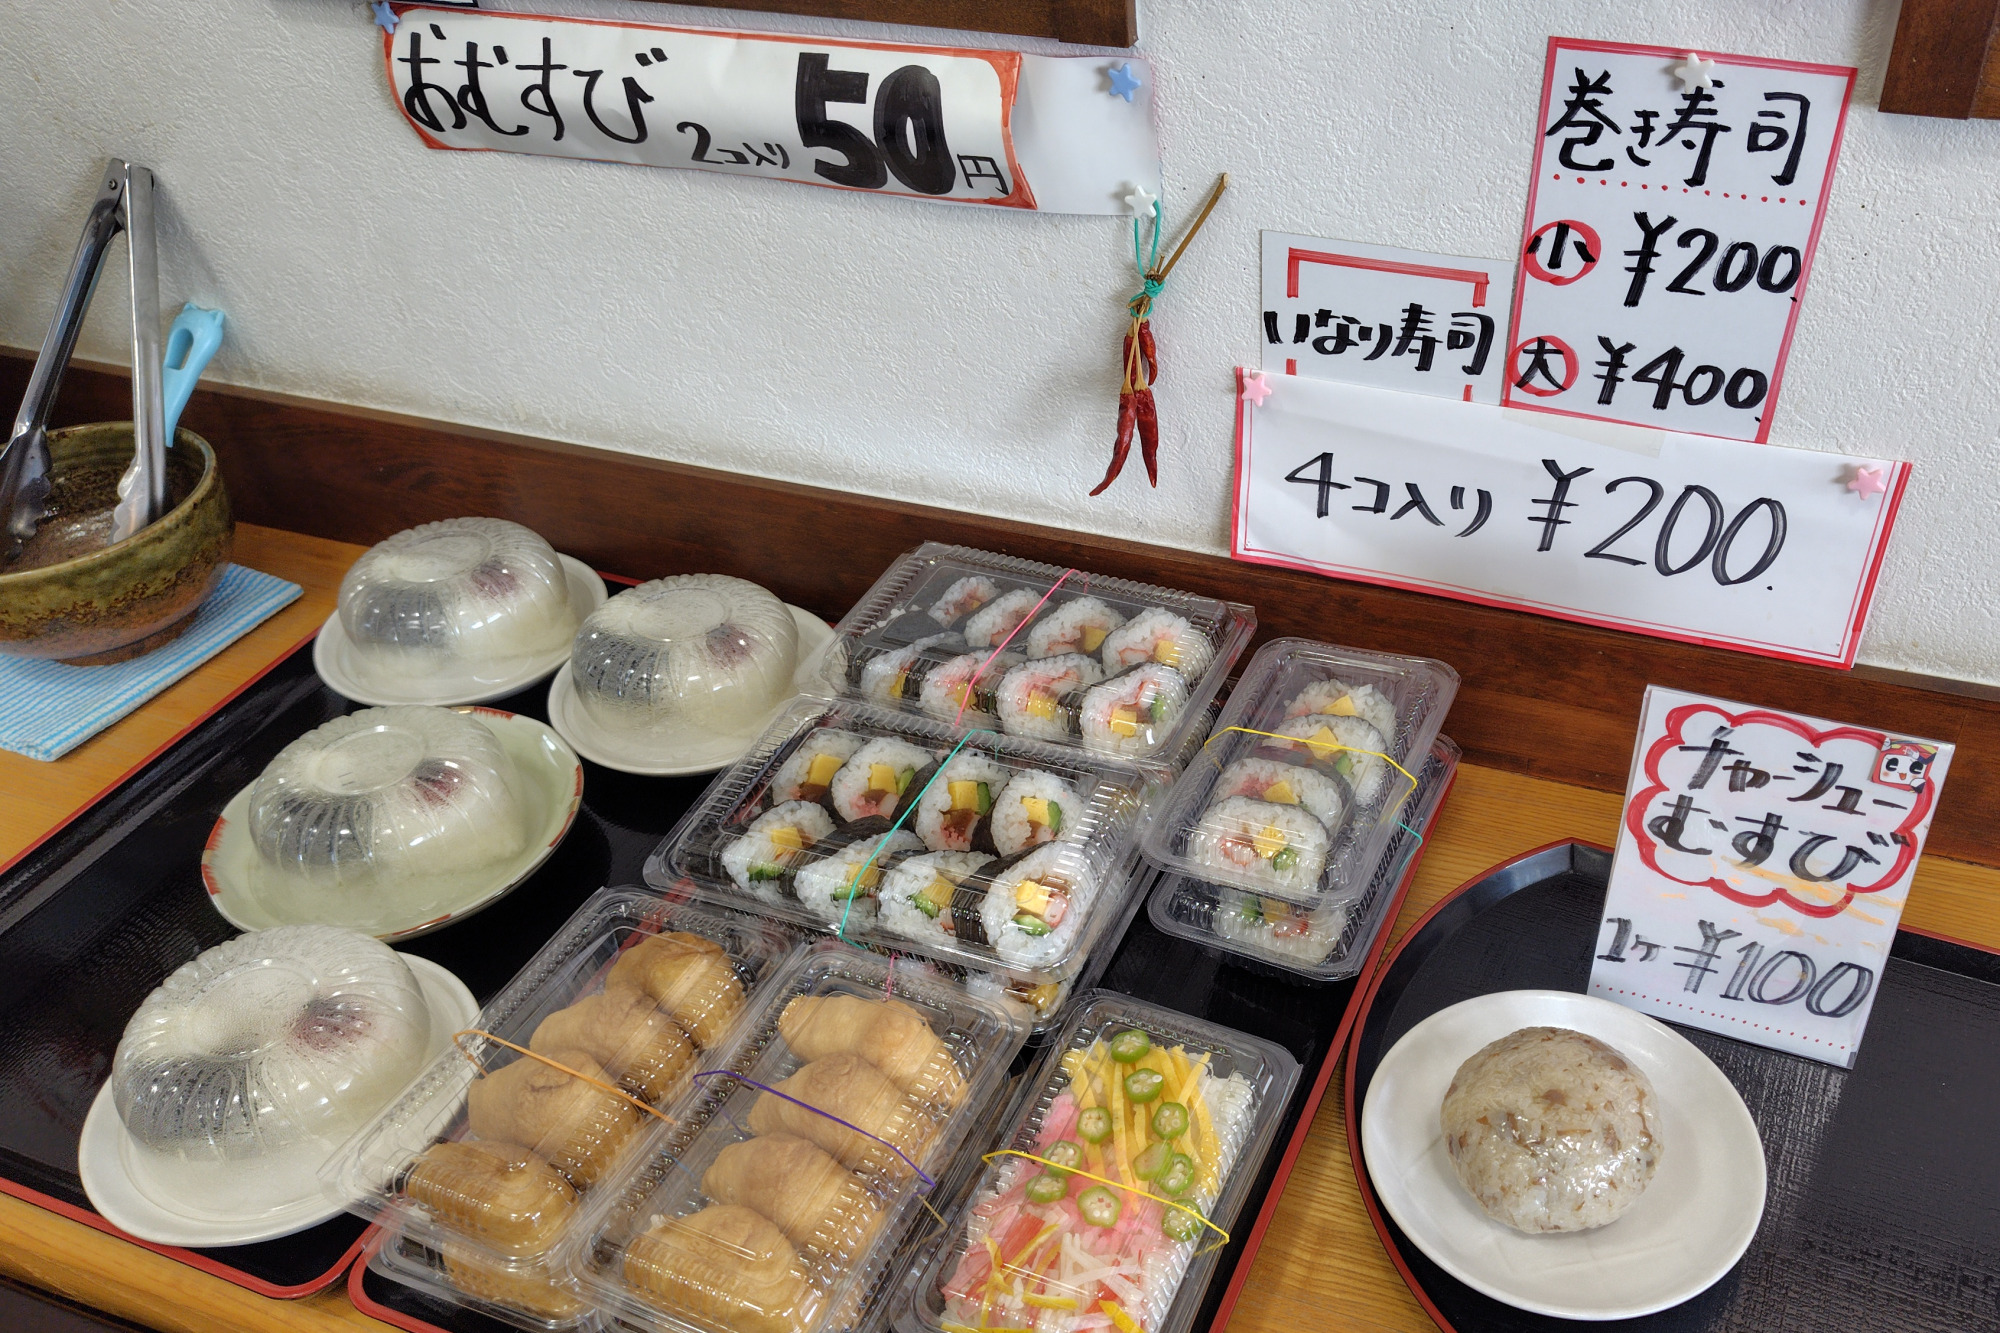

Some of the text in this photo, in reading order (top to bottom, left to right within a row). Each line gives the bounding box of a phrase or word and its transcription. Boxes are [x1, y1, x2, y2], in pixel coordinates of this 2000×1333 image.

[396, 23, 668, 143] おむすび
[676, 121, 790, 170] 2コ入り
[1545, 67, 1811, 187] 巻き寿司
[1264, 303, 1495, 375] いなり寿司
[1515, 337, 1567, 391] 大
[1284, 452, 1492, 537] 4コ入り
[1678, 725, 1907, 815] チャーシュー
[1647, 795, 1911, 882] むすび
[1673, 919, 1874, 1018] ¥100
